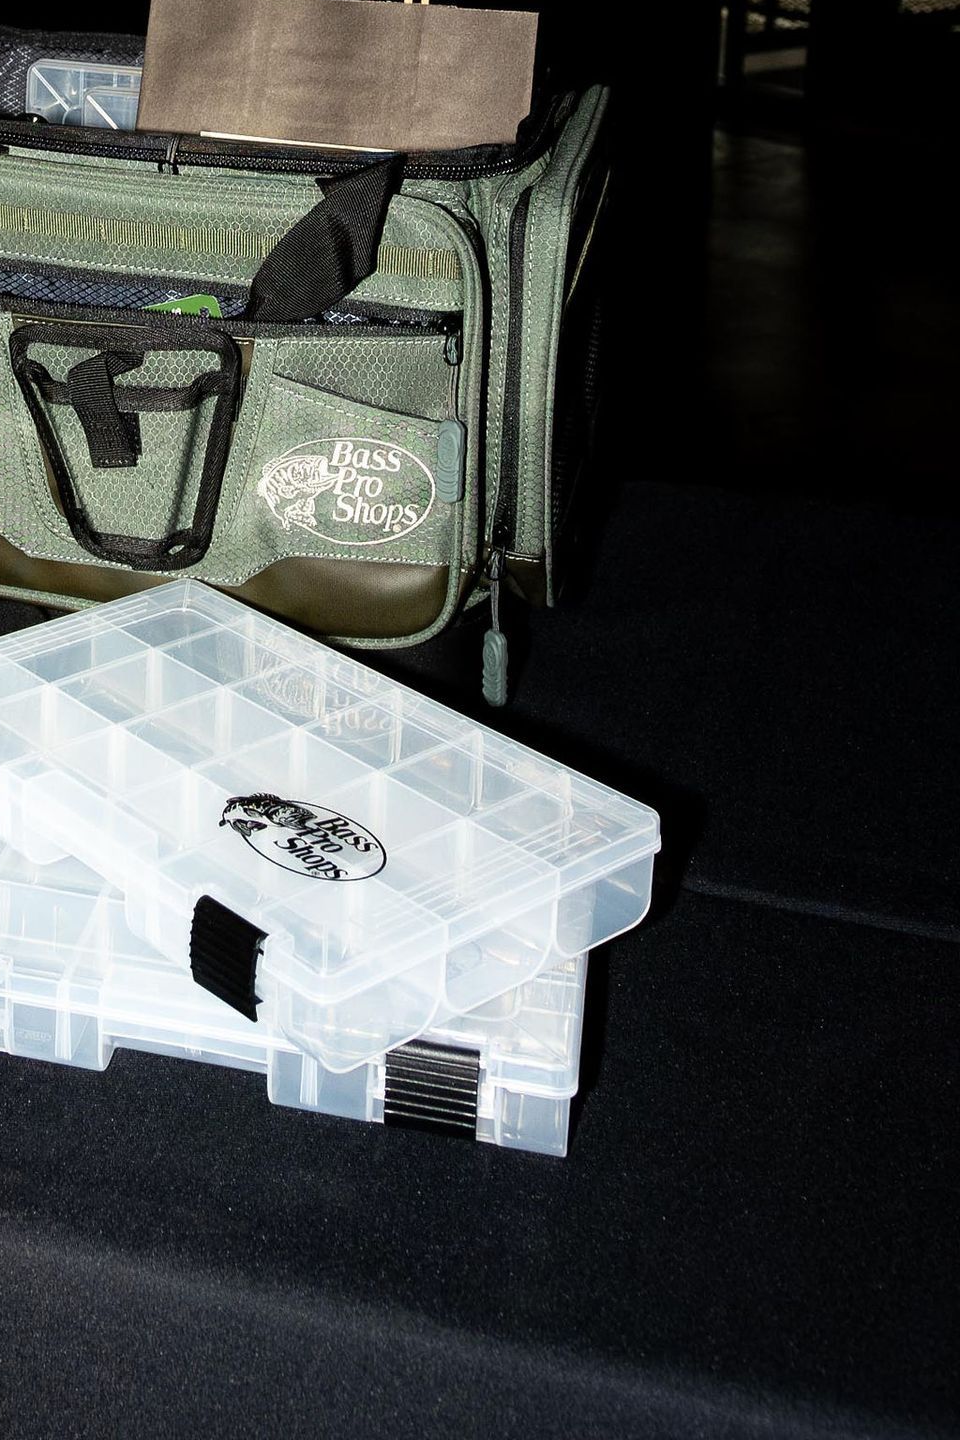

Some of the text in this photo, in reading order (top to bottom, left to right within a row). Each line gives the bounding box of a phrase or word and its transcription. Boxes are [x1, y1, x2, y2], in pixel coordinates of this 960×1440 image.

[329, 441, 402, 472] Bass
[332, 467, 384, 498] Pro
[332, 493, 420, 533] Shops
[296, 827, 343, 853] Pro
[315, 816, 379, 853] Bass
[273, 837, 349, 879] Shops
